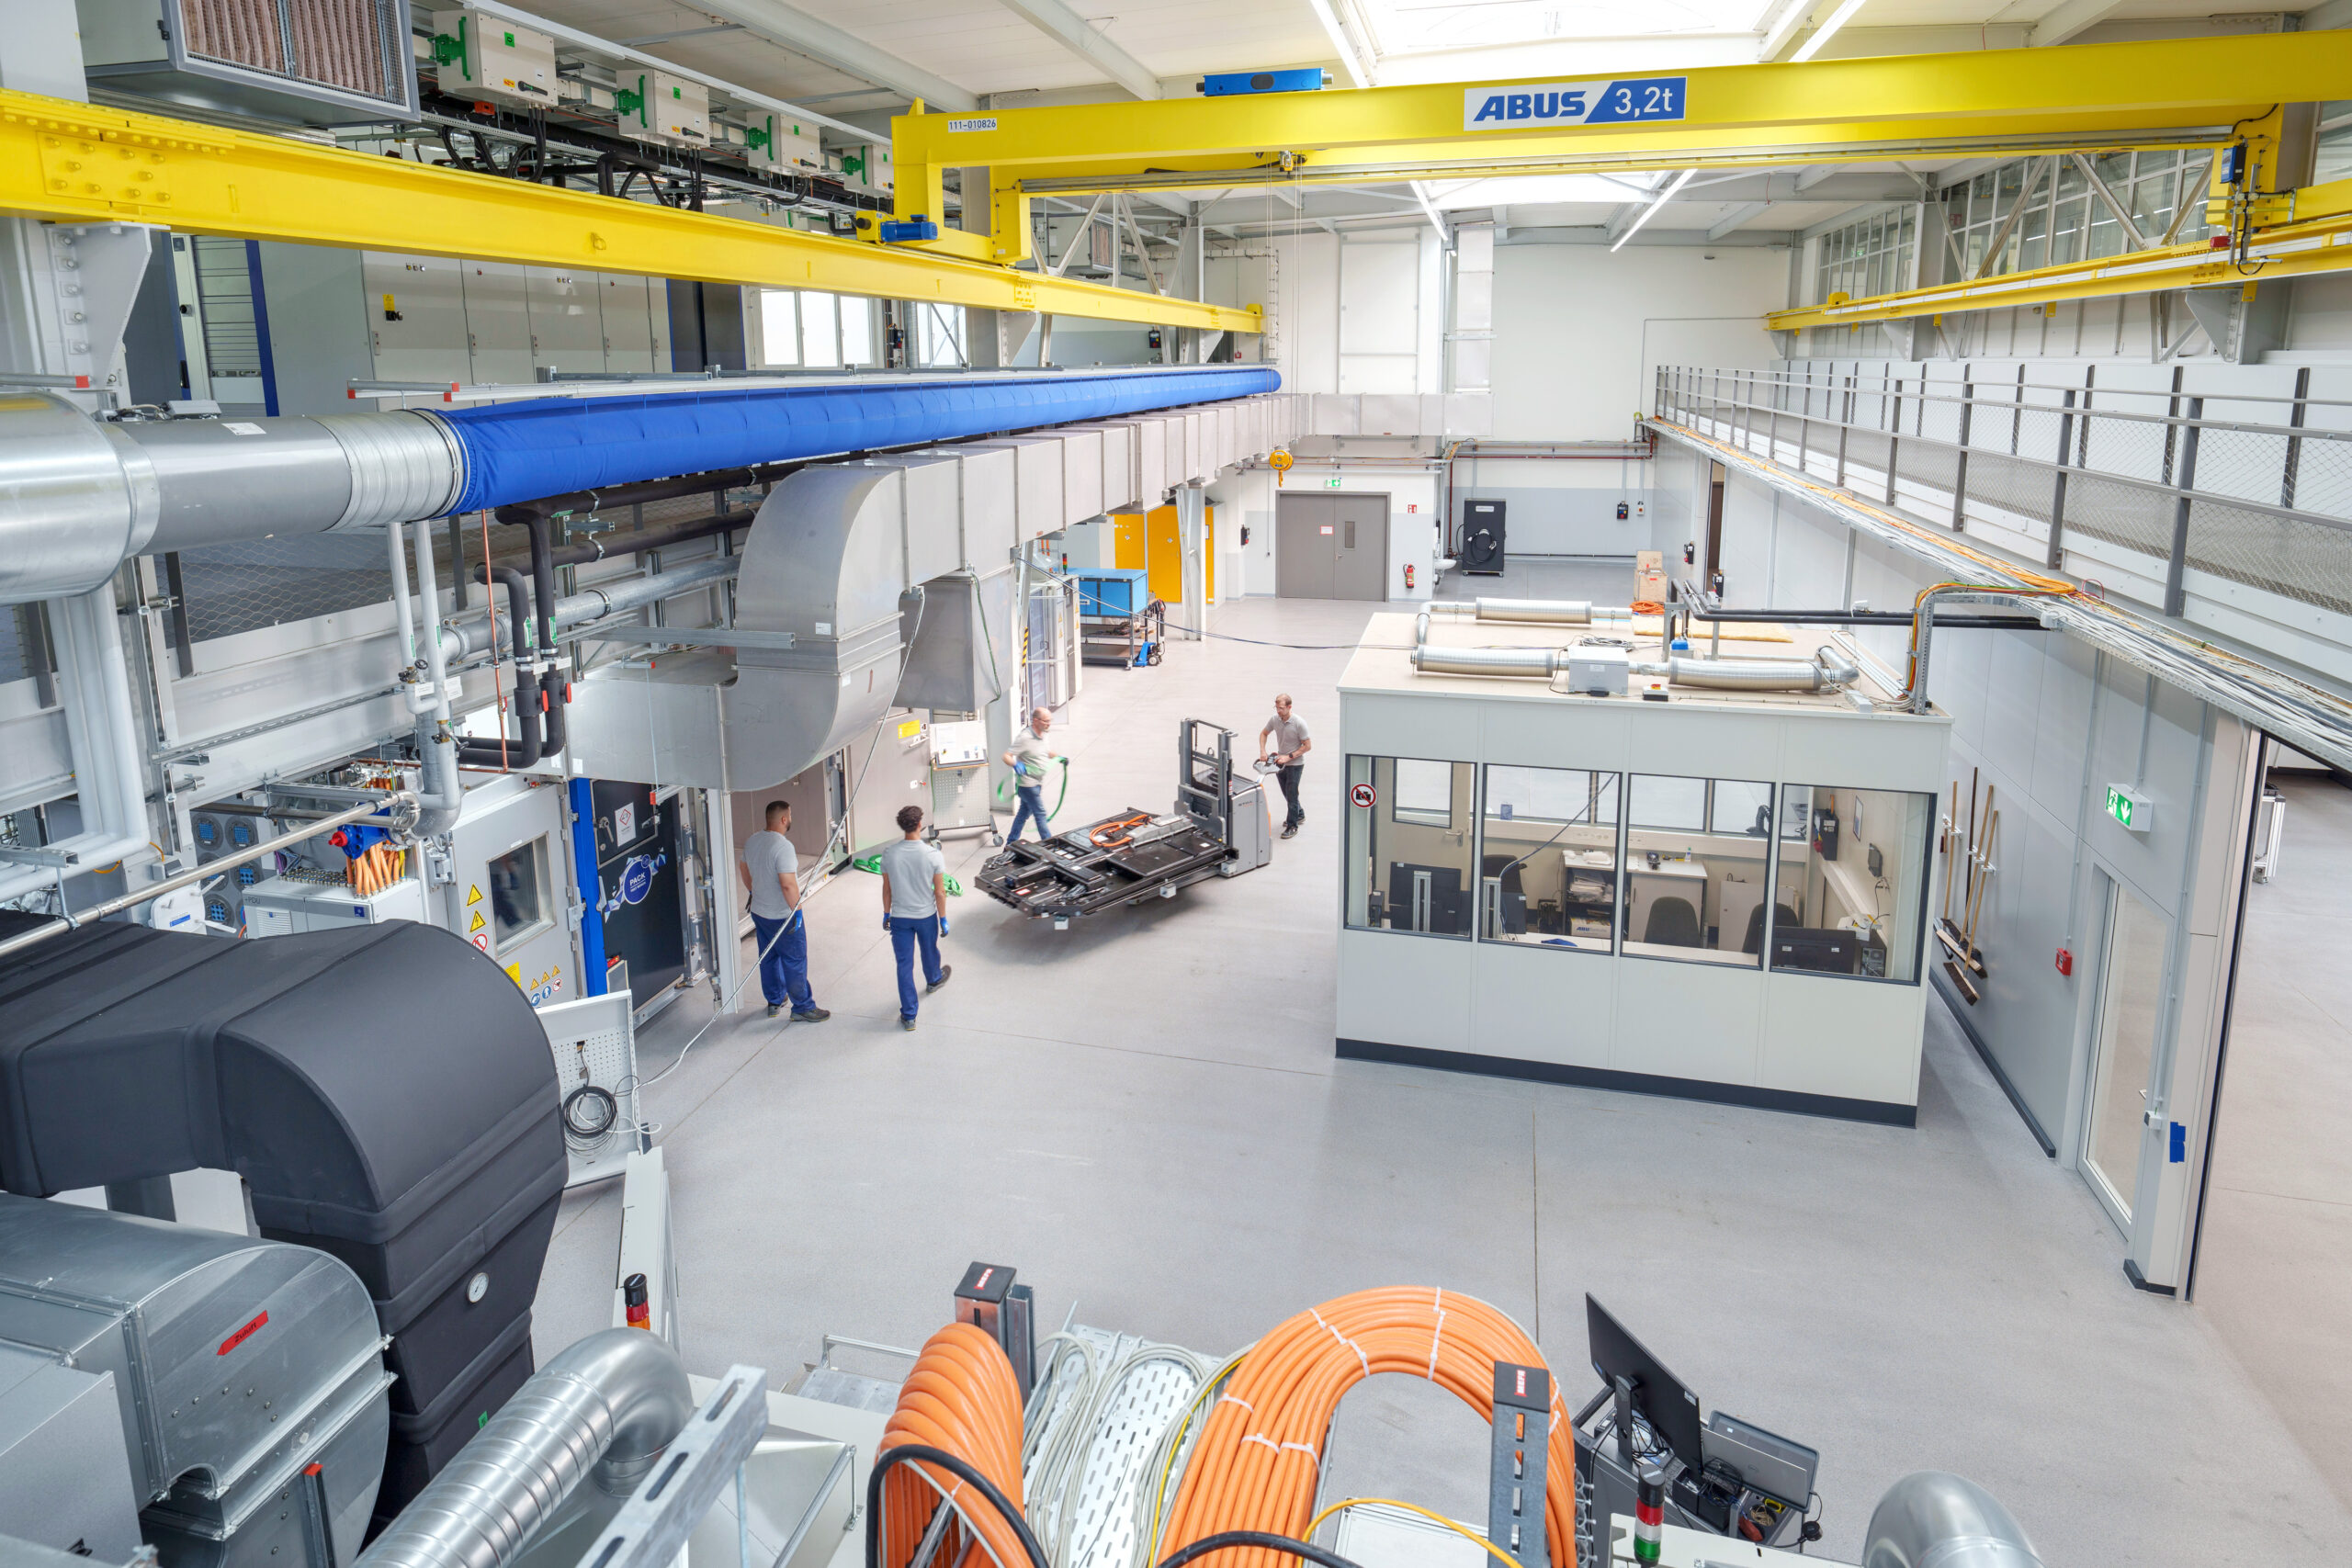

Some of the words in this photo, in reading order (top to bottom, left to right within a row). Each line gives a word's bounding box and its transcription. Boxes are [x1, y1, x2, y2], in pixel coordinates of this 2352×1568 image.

[1473, 91, 1587, 122] ABUS
[1614, 86, 1673, 118] 3,2t
[949, 119, 997, 130] 111-010826
[629, 872, 646, 886] PACK
[235, 1322, 256, 1343] Zuluft
